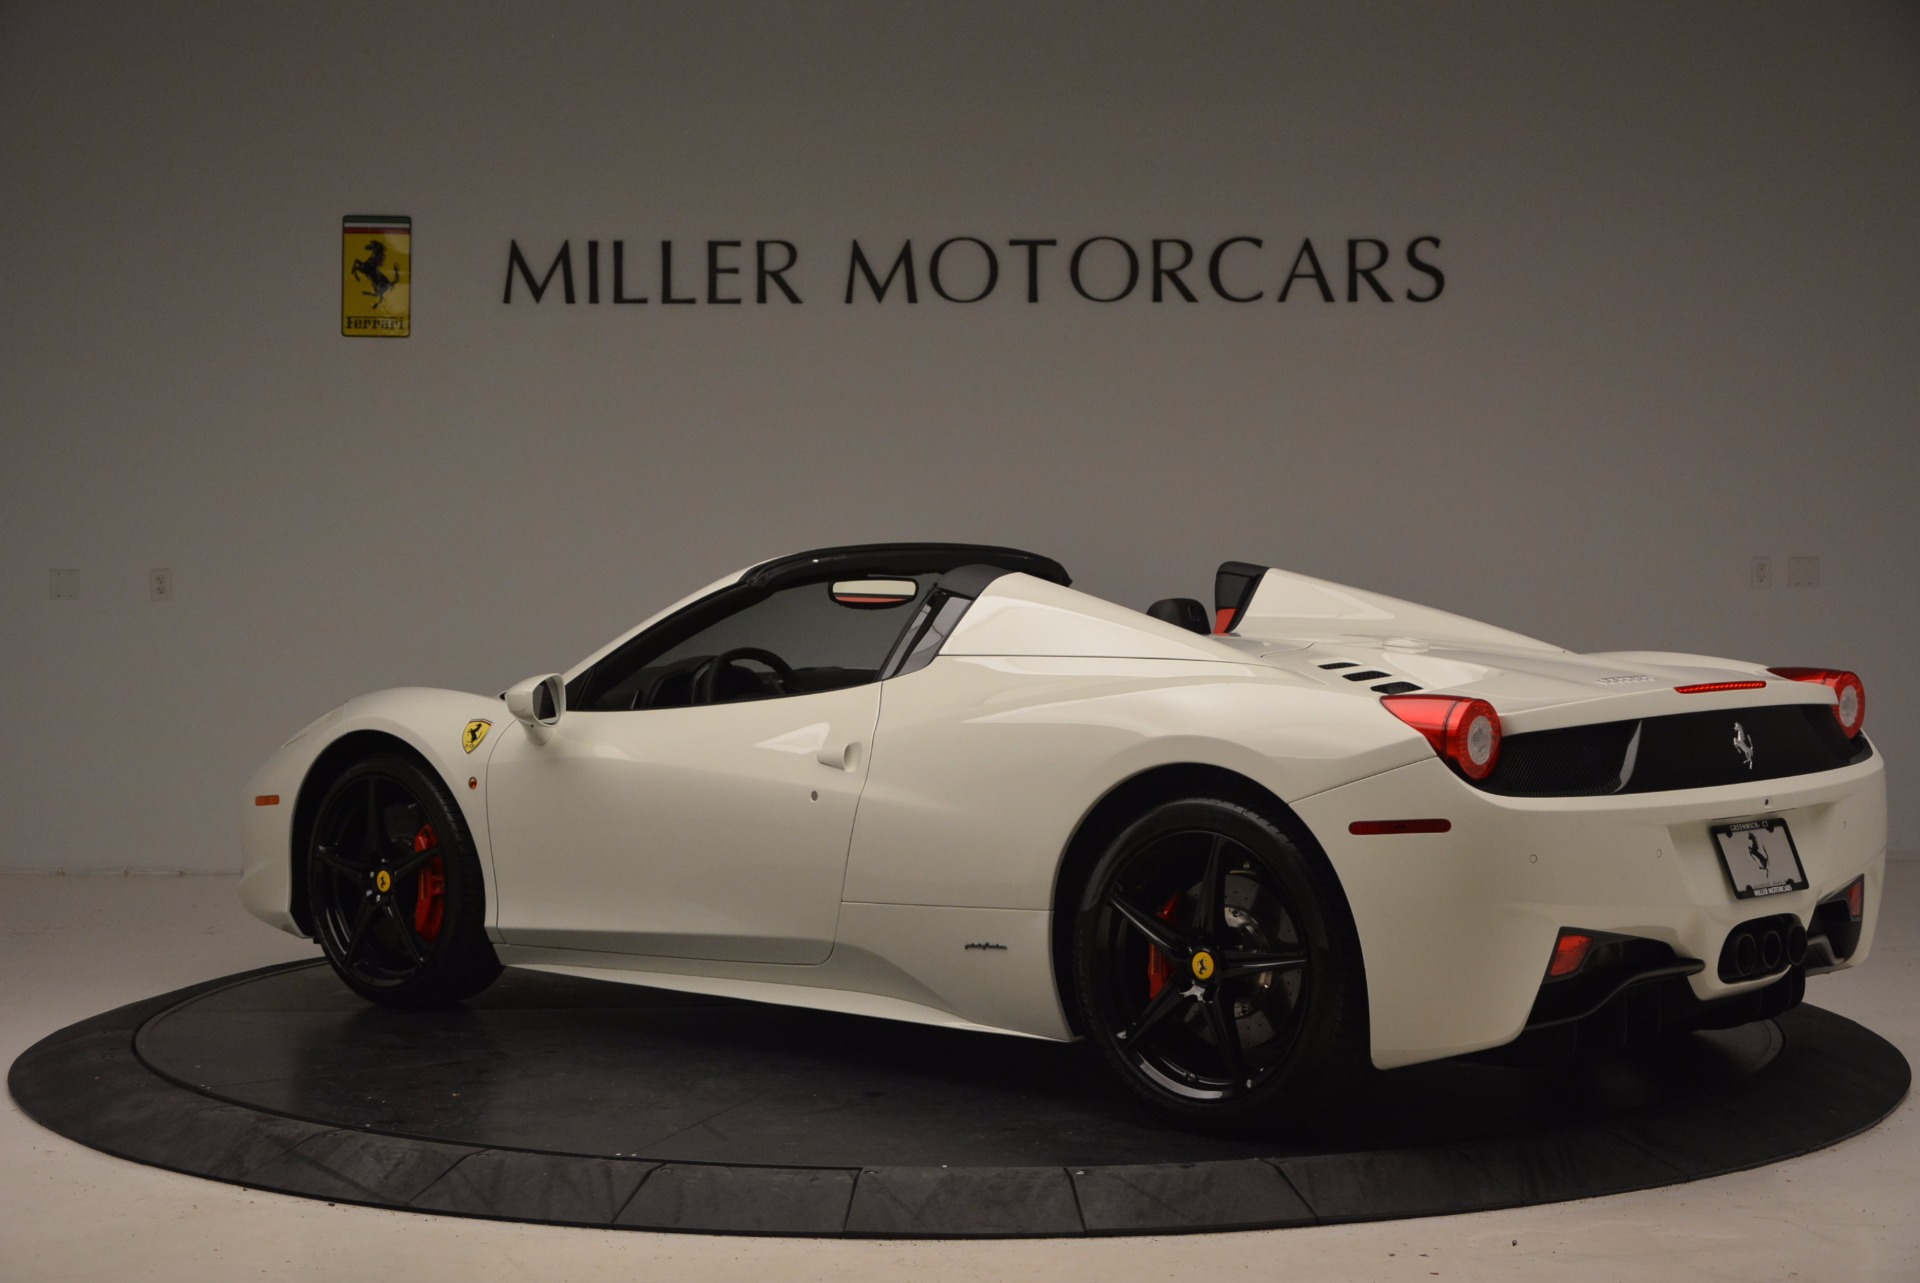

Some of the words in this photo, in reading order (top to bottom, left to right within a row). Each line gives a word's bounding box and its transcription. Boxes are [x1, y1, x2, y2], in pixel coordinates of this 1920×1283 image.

[502, 238, 805, 305] MILLER
[843, 235, 1446, 304] MOTORCARS
[345, 316, 404, 330] Ferrari
